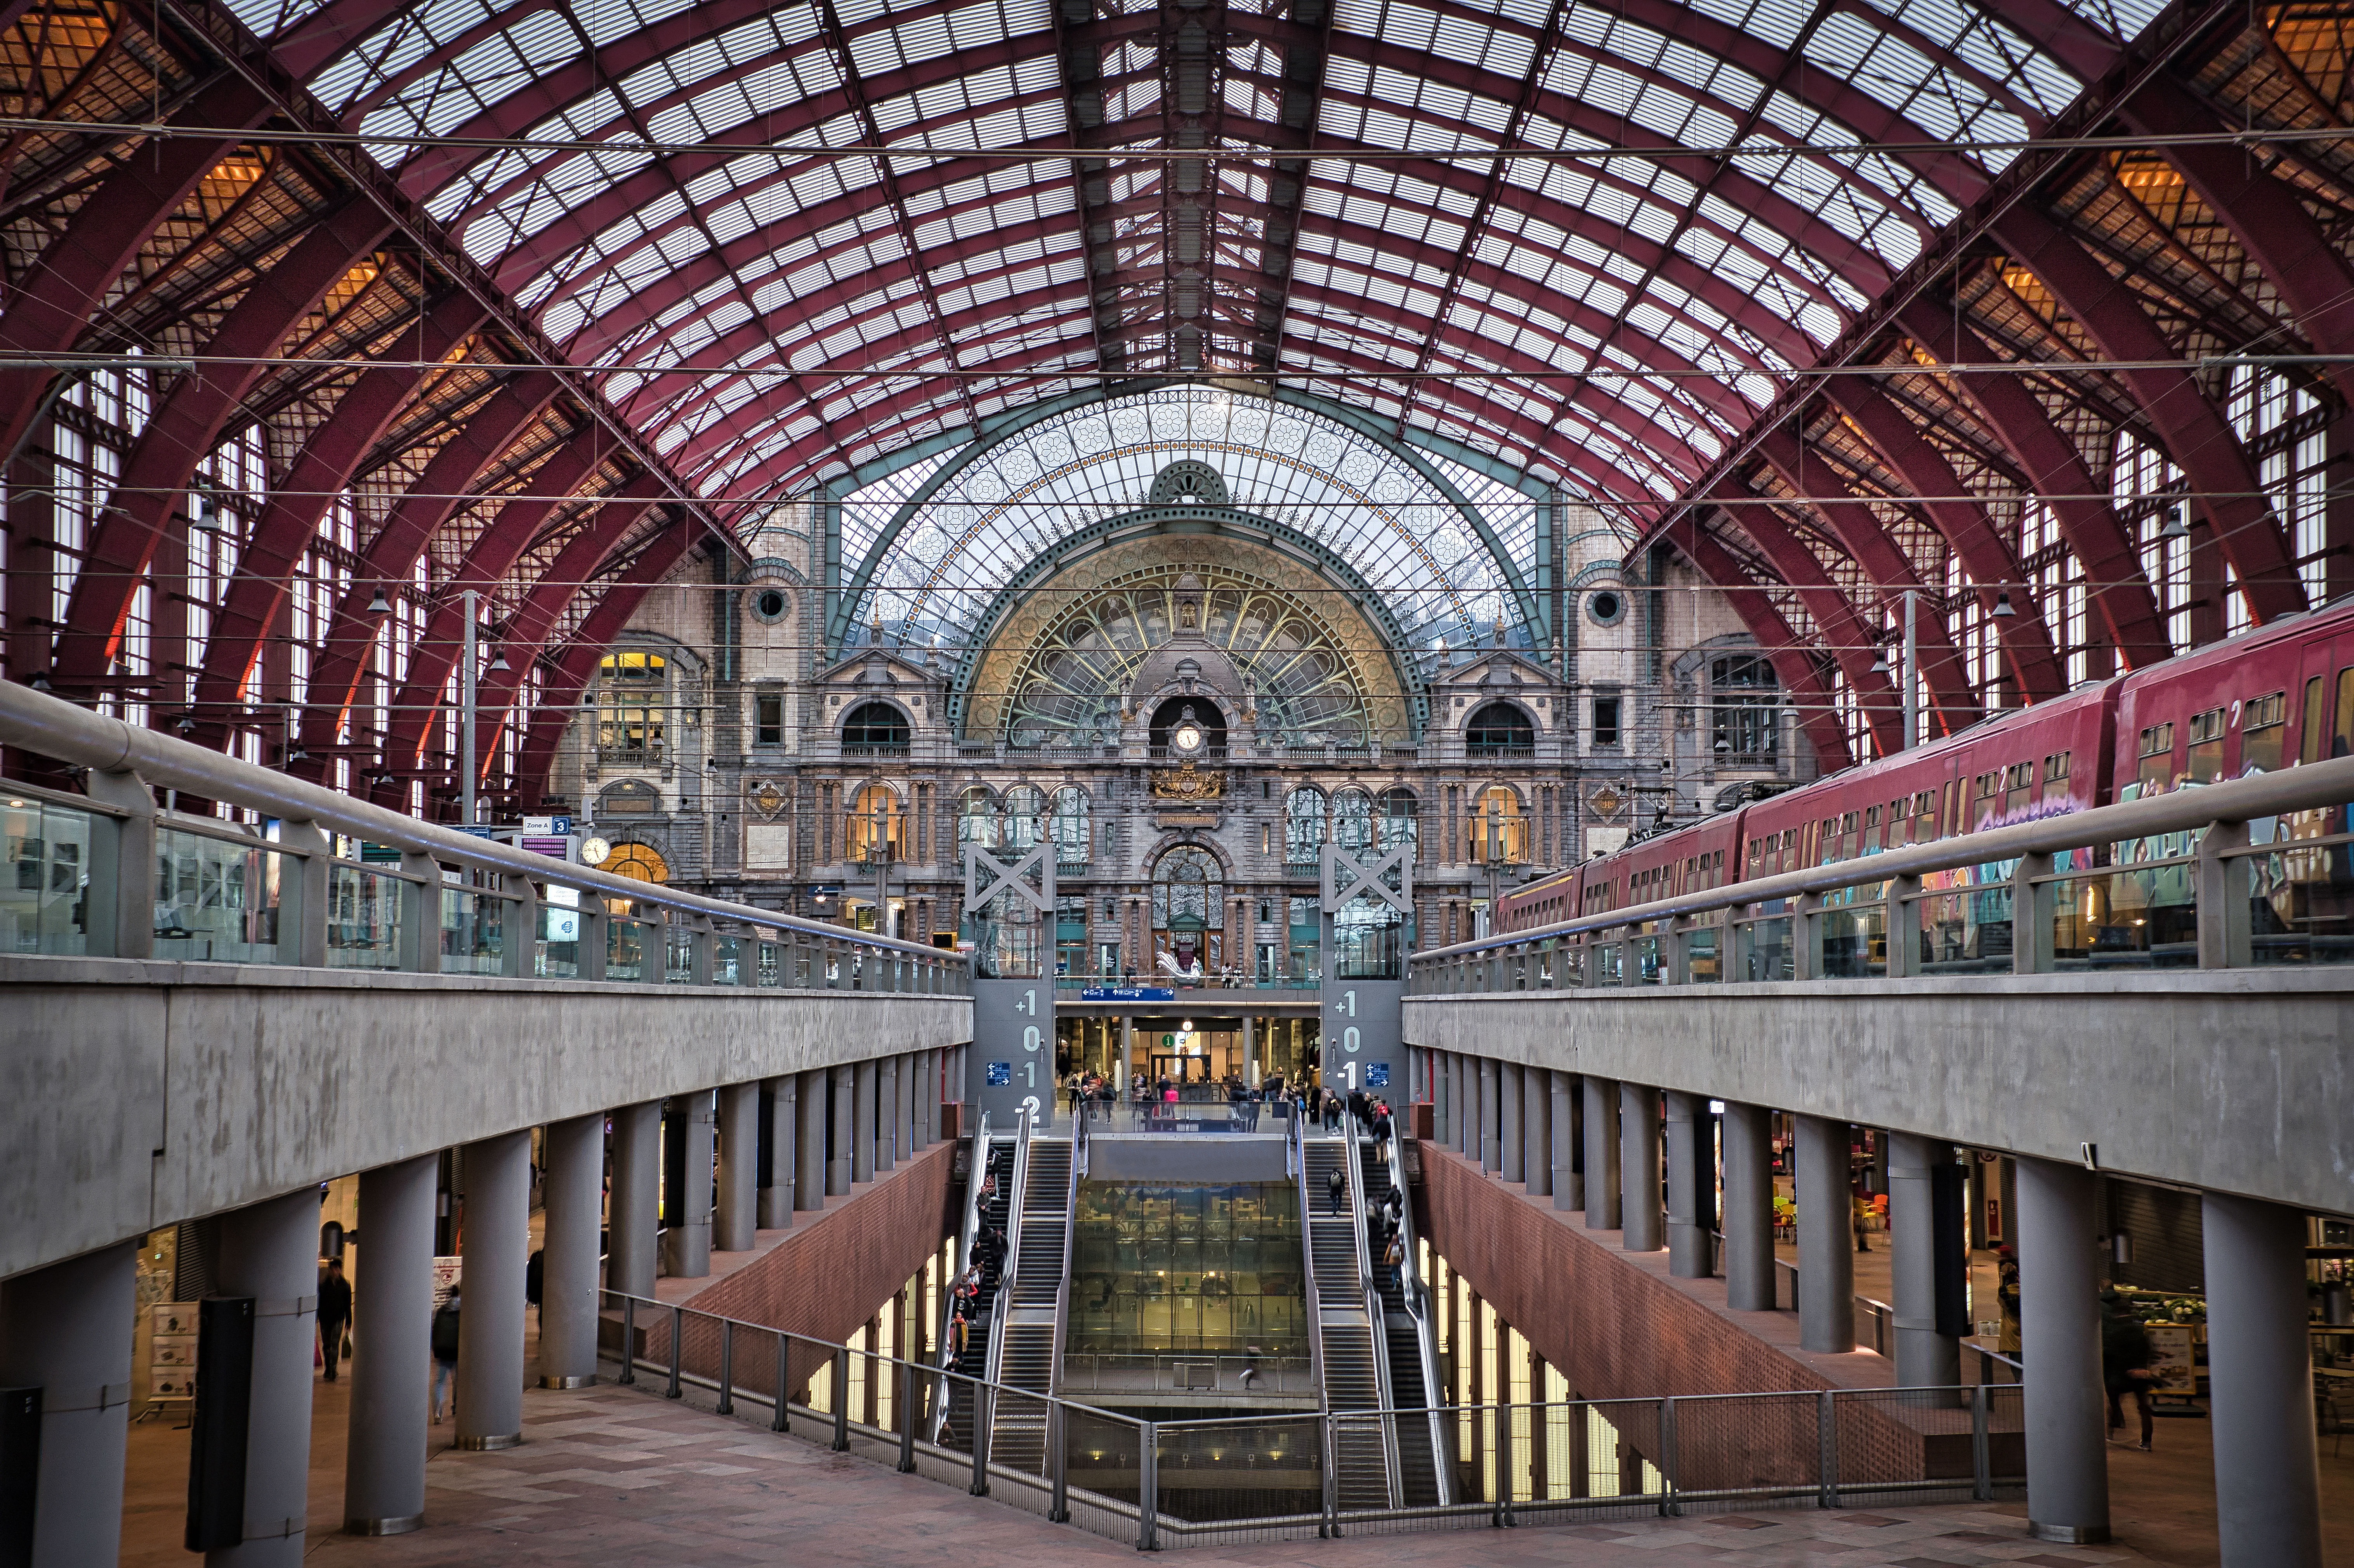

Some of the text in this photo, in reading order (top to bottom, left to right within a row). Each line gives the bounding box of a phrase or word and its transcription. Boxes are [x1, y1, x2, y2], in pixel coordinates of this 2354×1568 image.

[1999, 765, 2007, 793] 2
[1909, 792, 1916, 817] 2
[557, 822, 564, 831] 3
[1837, 812, 1844, 835] 2
[1779, 829, 1785, 850] 2
[1015, 989, 1036, 1016] +1
[1335, 990, 1356, 1017] +1
[1023, 1025, 1041, 1052] 0
[1344, 1025, 1361, 1053] 0
[1017, 1061, 1036, 1089] -1
[1337, 1061, 1356, 1090] -1
